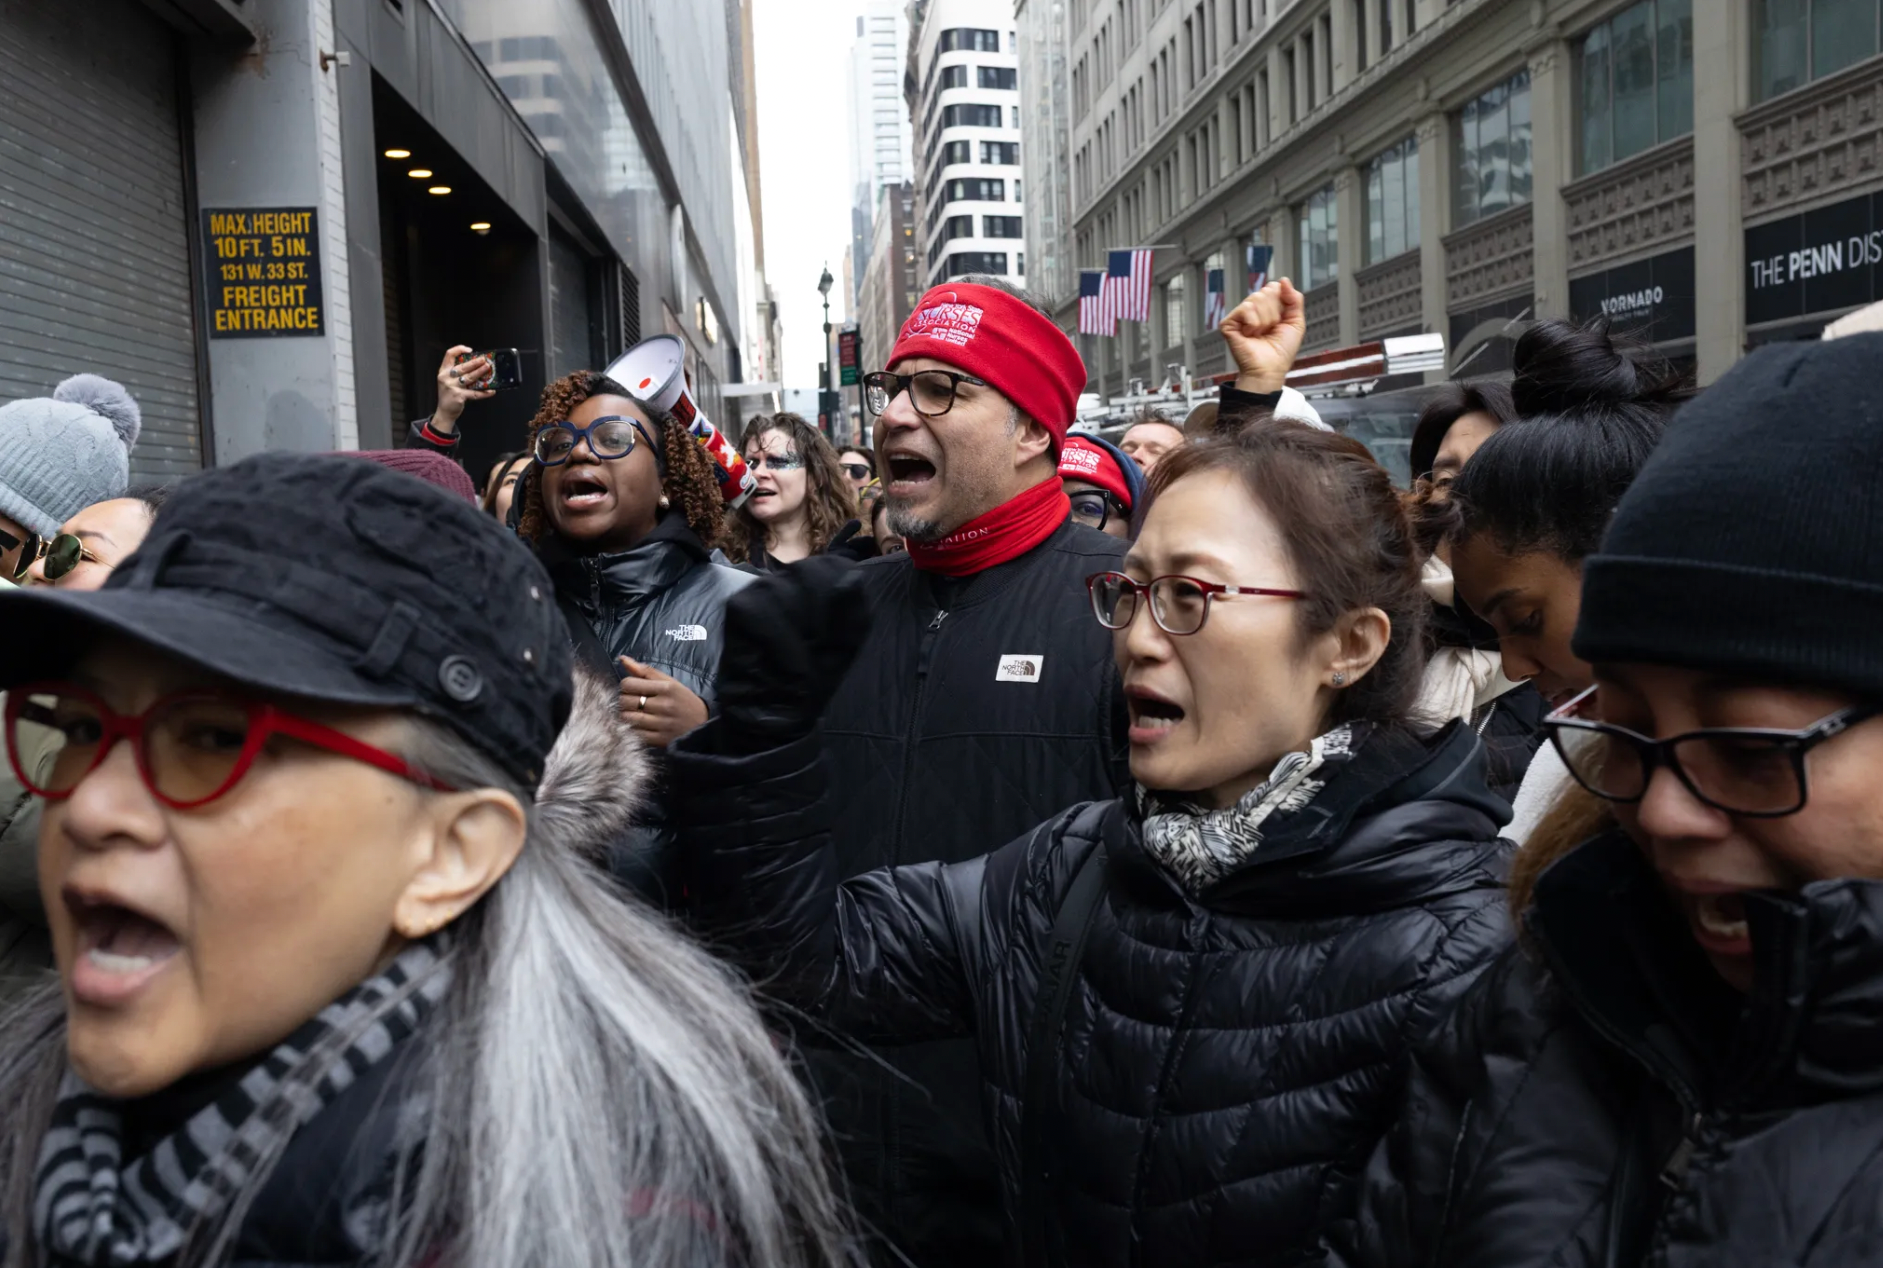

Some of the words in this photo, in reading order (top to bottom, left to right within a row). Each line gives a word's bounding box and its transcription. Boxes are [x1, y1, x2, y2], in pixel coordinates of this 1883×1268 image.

[253, 212, 311, 234] HEIGHT
[214, 236, 237, 258] 10
[240, 238, 264, 257] FT.
[271, 236, 285, 257] 5
[286, 237, 311, 257] IN.
[220, 263, 244, 280] 131
[246, 263, 265, 280] W.
[267, 262, 285, 280] 33
[287, 261, 308, 279] ST.
[1750, 255, 1784, 289] THE
[1789, 240, 1842, 281] PENN
[1849, 230, 1883, 268] DIS
[223, 284, 307, 307] FREIGHT
[1601, 285, 1663, 316] VORNADO
[215, 307, 319, 331] ENTRANCE
